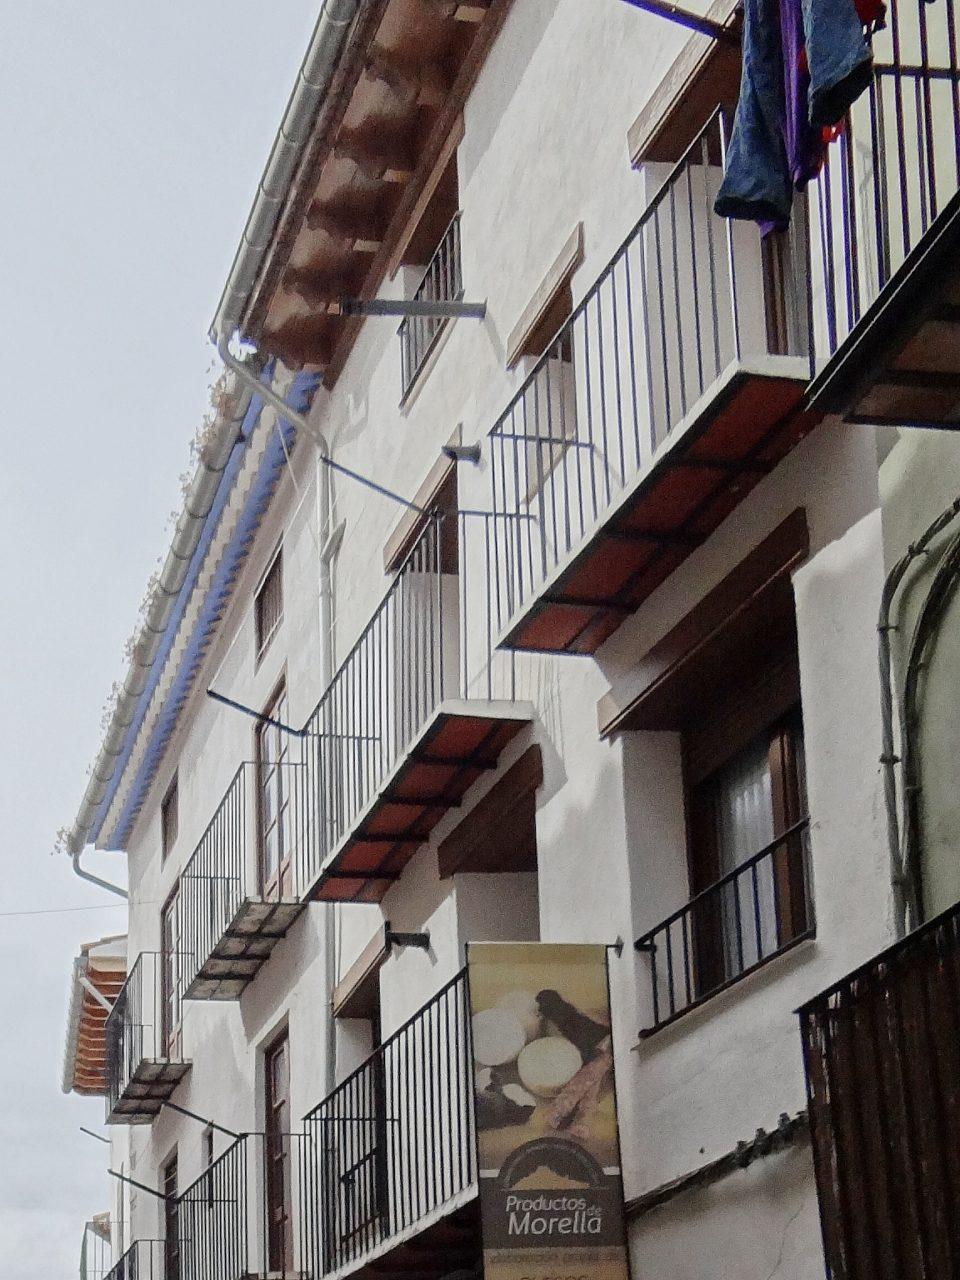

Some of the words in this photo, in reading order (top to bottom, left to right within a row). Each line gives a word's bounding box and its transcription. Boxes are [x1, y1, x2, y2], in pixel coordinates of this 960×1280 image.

[505, 1194, 587, 1212] Productos
[587, 1204, 603, 1216] de
[508, 1211, 602, 1235] Morella
